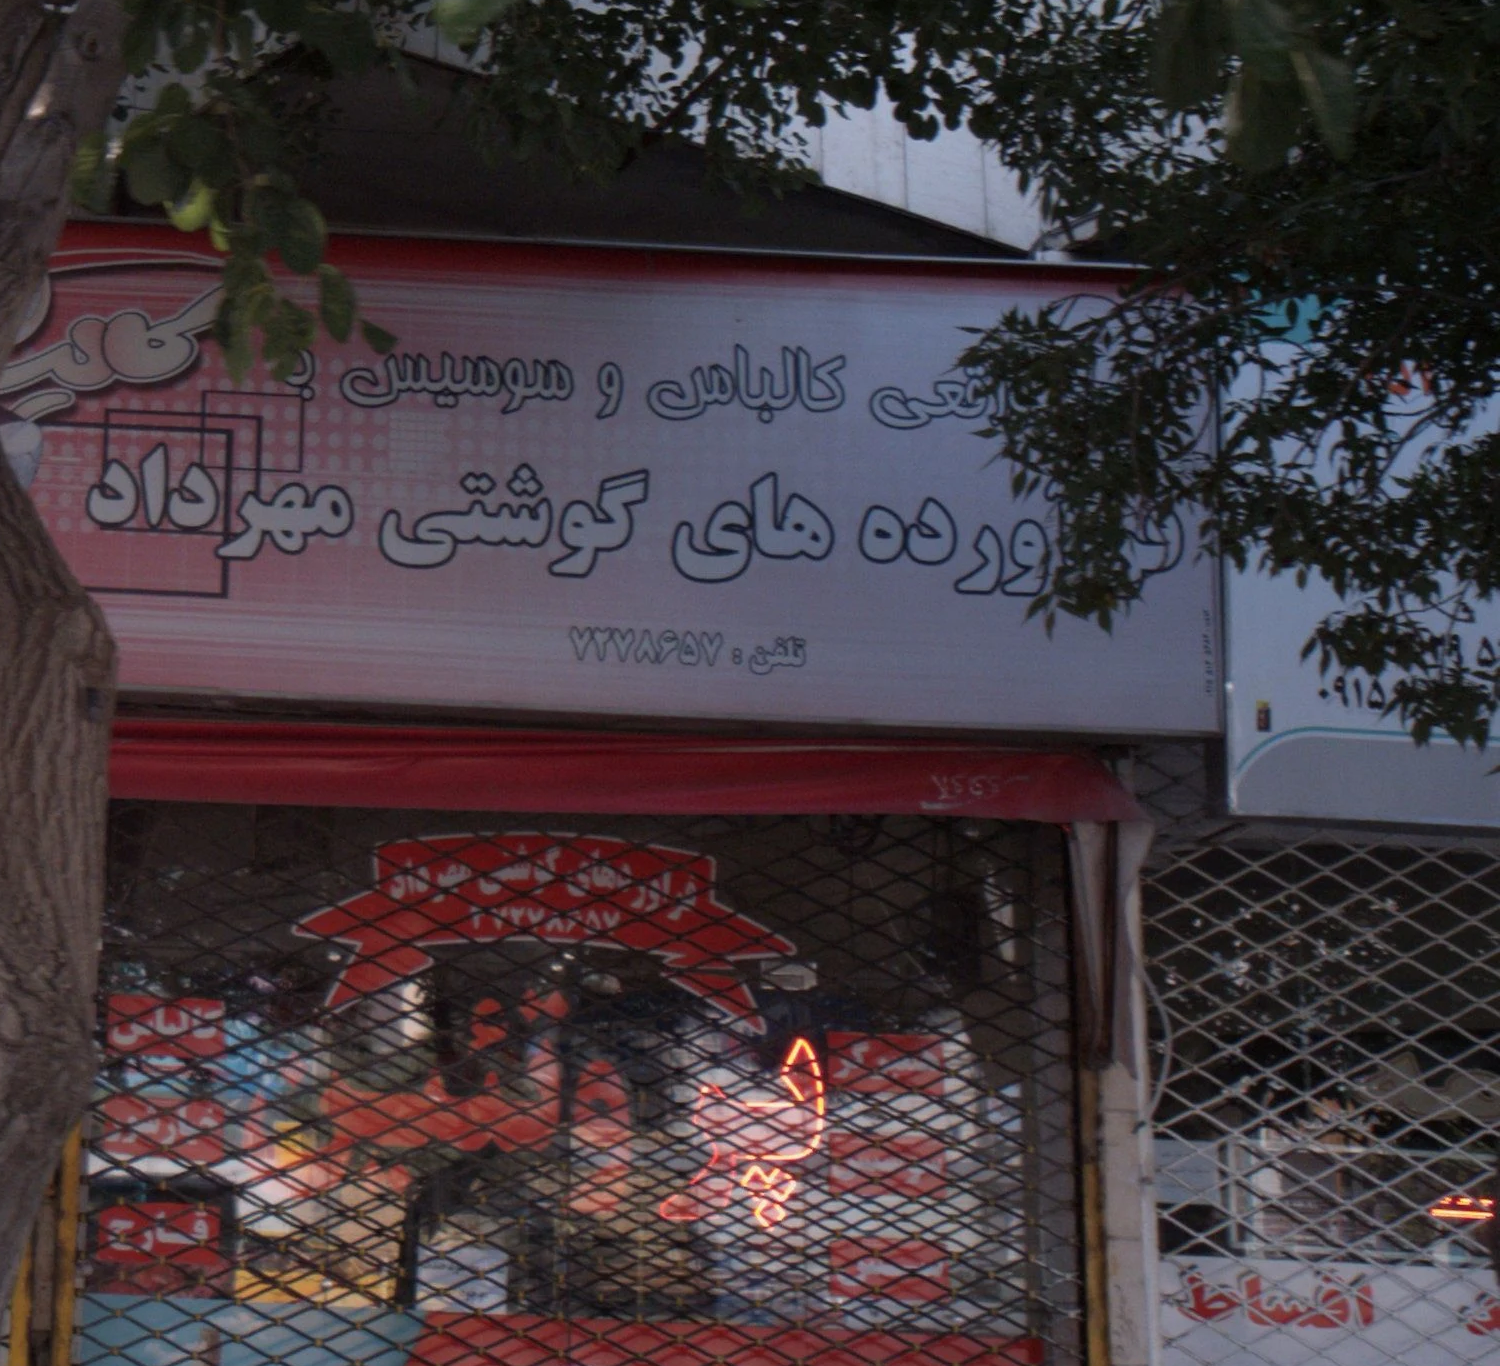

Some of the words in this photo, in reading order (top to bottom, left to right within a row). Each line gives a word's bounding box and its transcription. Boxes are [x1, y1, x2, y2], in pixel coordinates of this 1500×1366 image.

[340, 351, 574, 416] سوسیس
[596, 362, 624, 419] و
[647, 344, 846, 423] کالباس
[86, 442, 354, 560] مهرداد
[380, 463, 649, 578] گوشتی
[673, 473, 834, 582] های
[1175, 1266, 1374, 1330] اقساط
